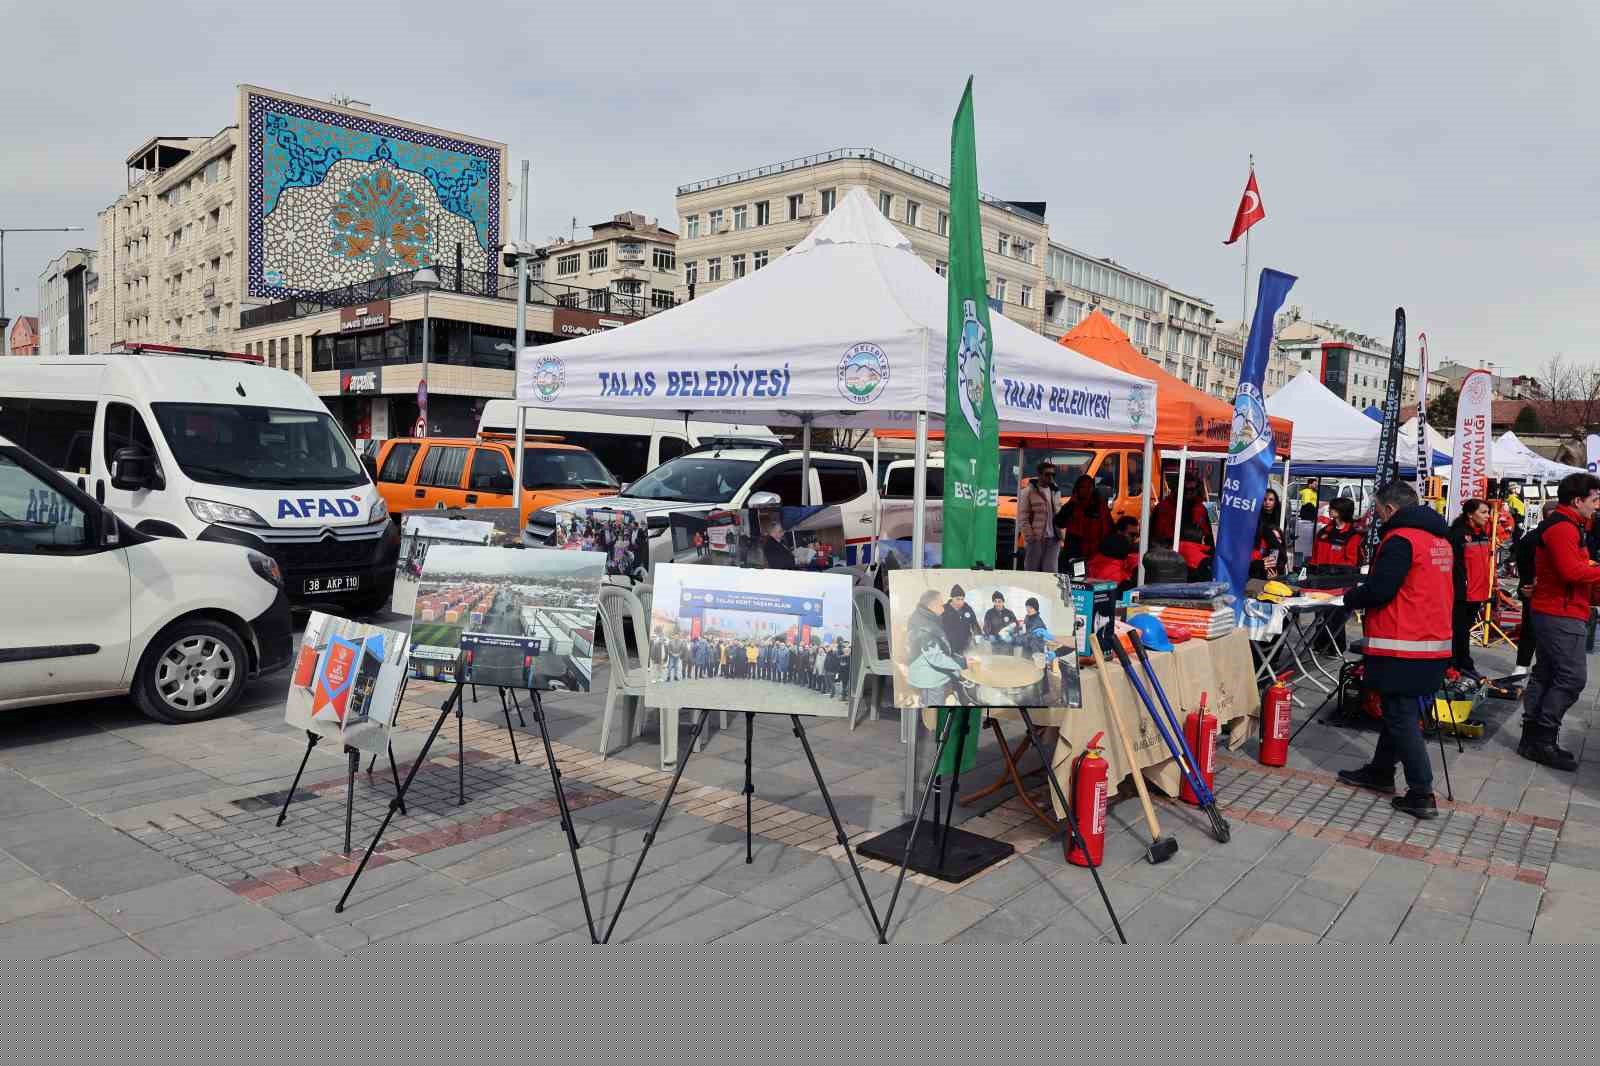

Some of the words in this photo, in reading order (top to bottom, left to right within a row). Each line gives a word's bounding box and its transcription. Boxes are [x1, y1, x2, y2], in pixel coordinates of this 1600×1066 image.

[599, 370, 657, 397] TALAS
[666, 363, 791, 397] BELEDİYESİ
[1003, 378, 1045, 410] TALAS
[1048, 386, 1112, 420] BELEDİYESİ
[1464, 418, 1473, 437] VE
[277, 498, 360, 519] AFAD
[308, 580, 320, 591] 38
[326, 578, 343, 590] AKP
[345, 577, 358, 588] 110
